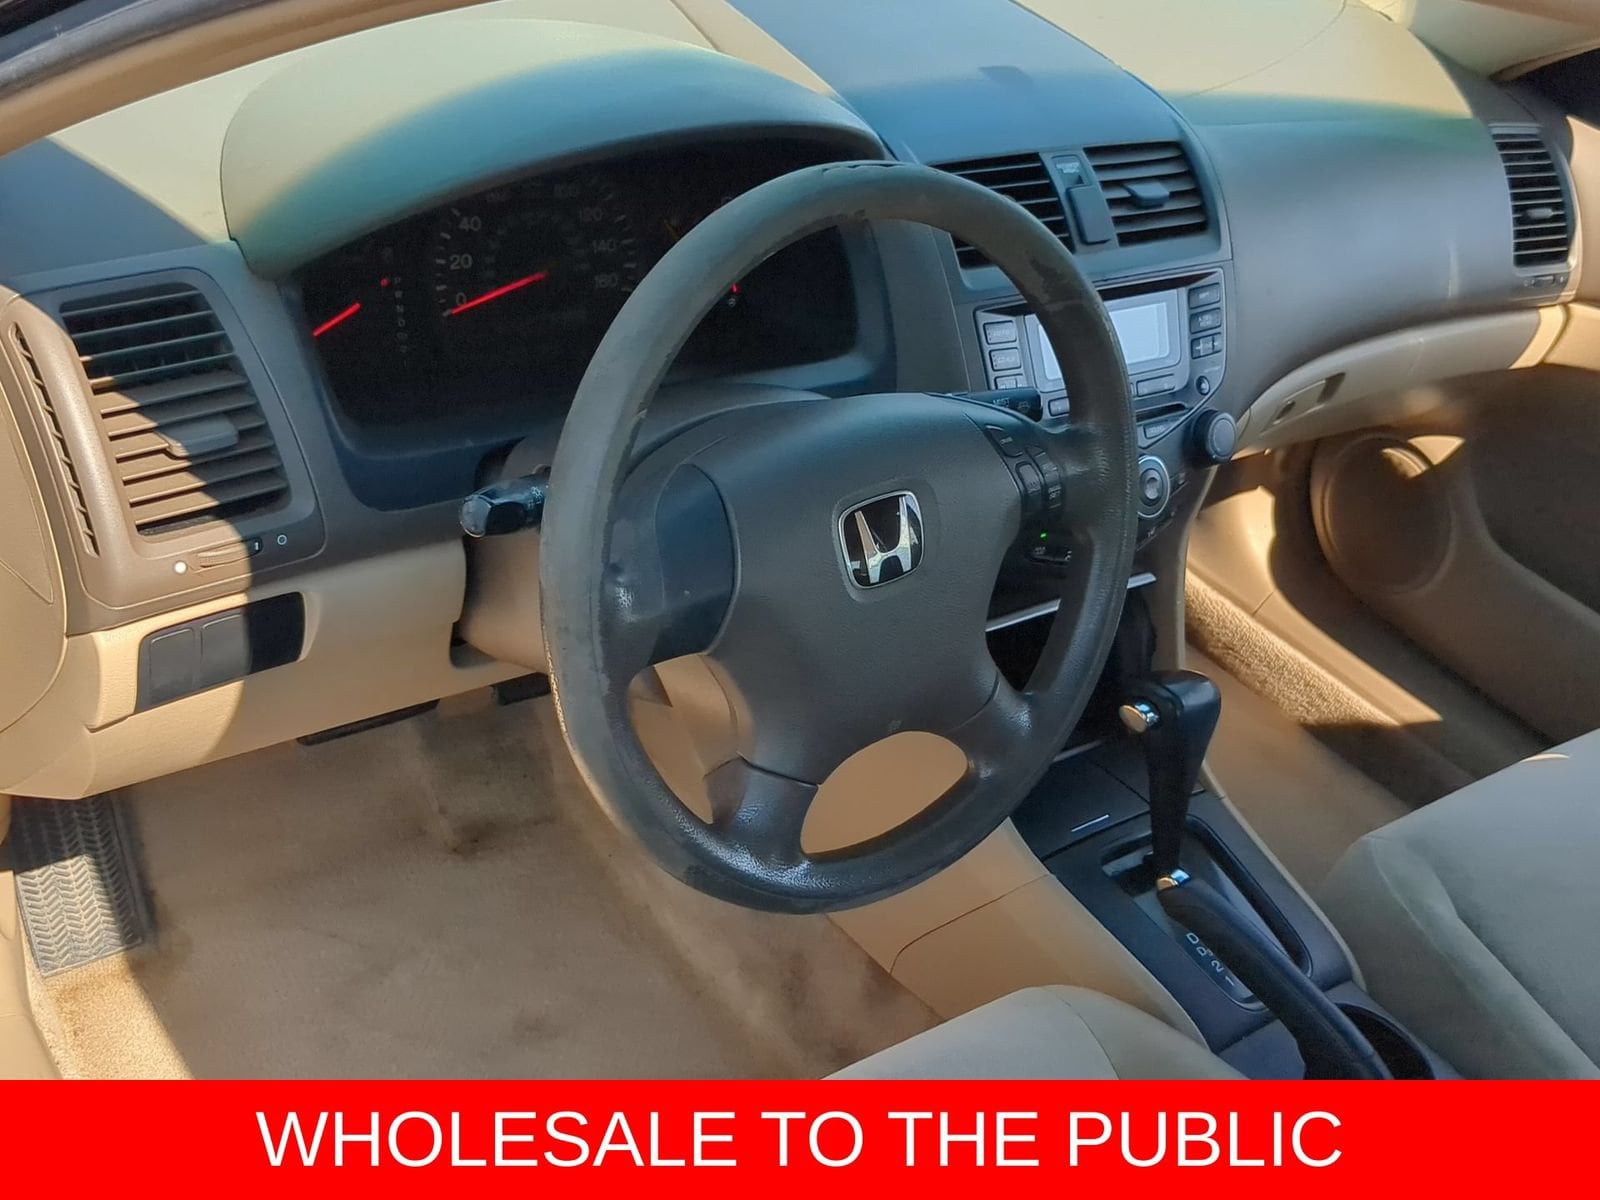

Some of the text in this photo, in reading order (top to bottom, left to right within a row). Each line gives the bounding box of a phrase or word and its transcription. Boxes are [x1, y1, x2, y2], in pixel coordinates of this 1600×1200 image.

[459, 215, 483, 232] 40
[449, 253, 473, 271] 20
[455, 292, 468, 306] 0
[1185, 932, 1200, 944] D
[1211, 959, 1225, 973] 2
